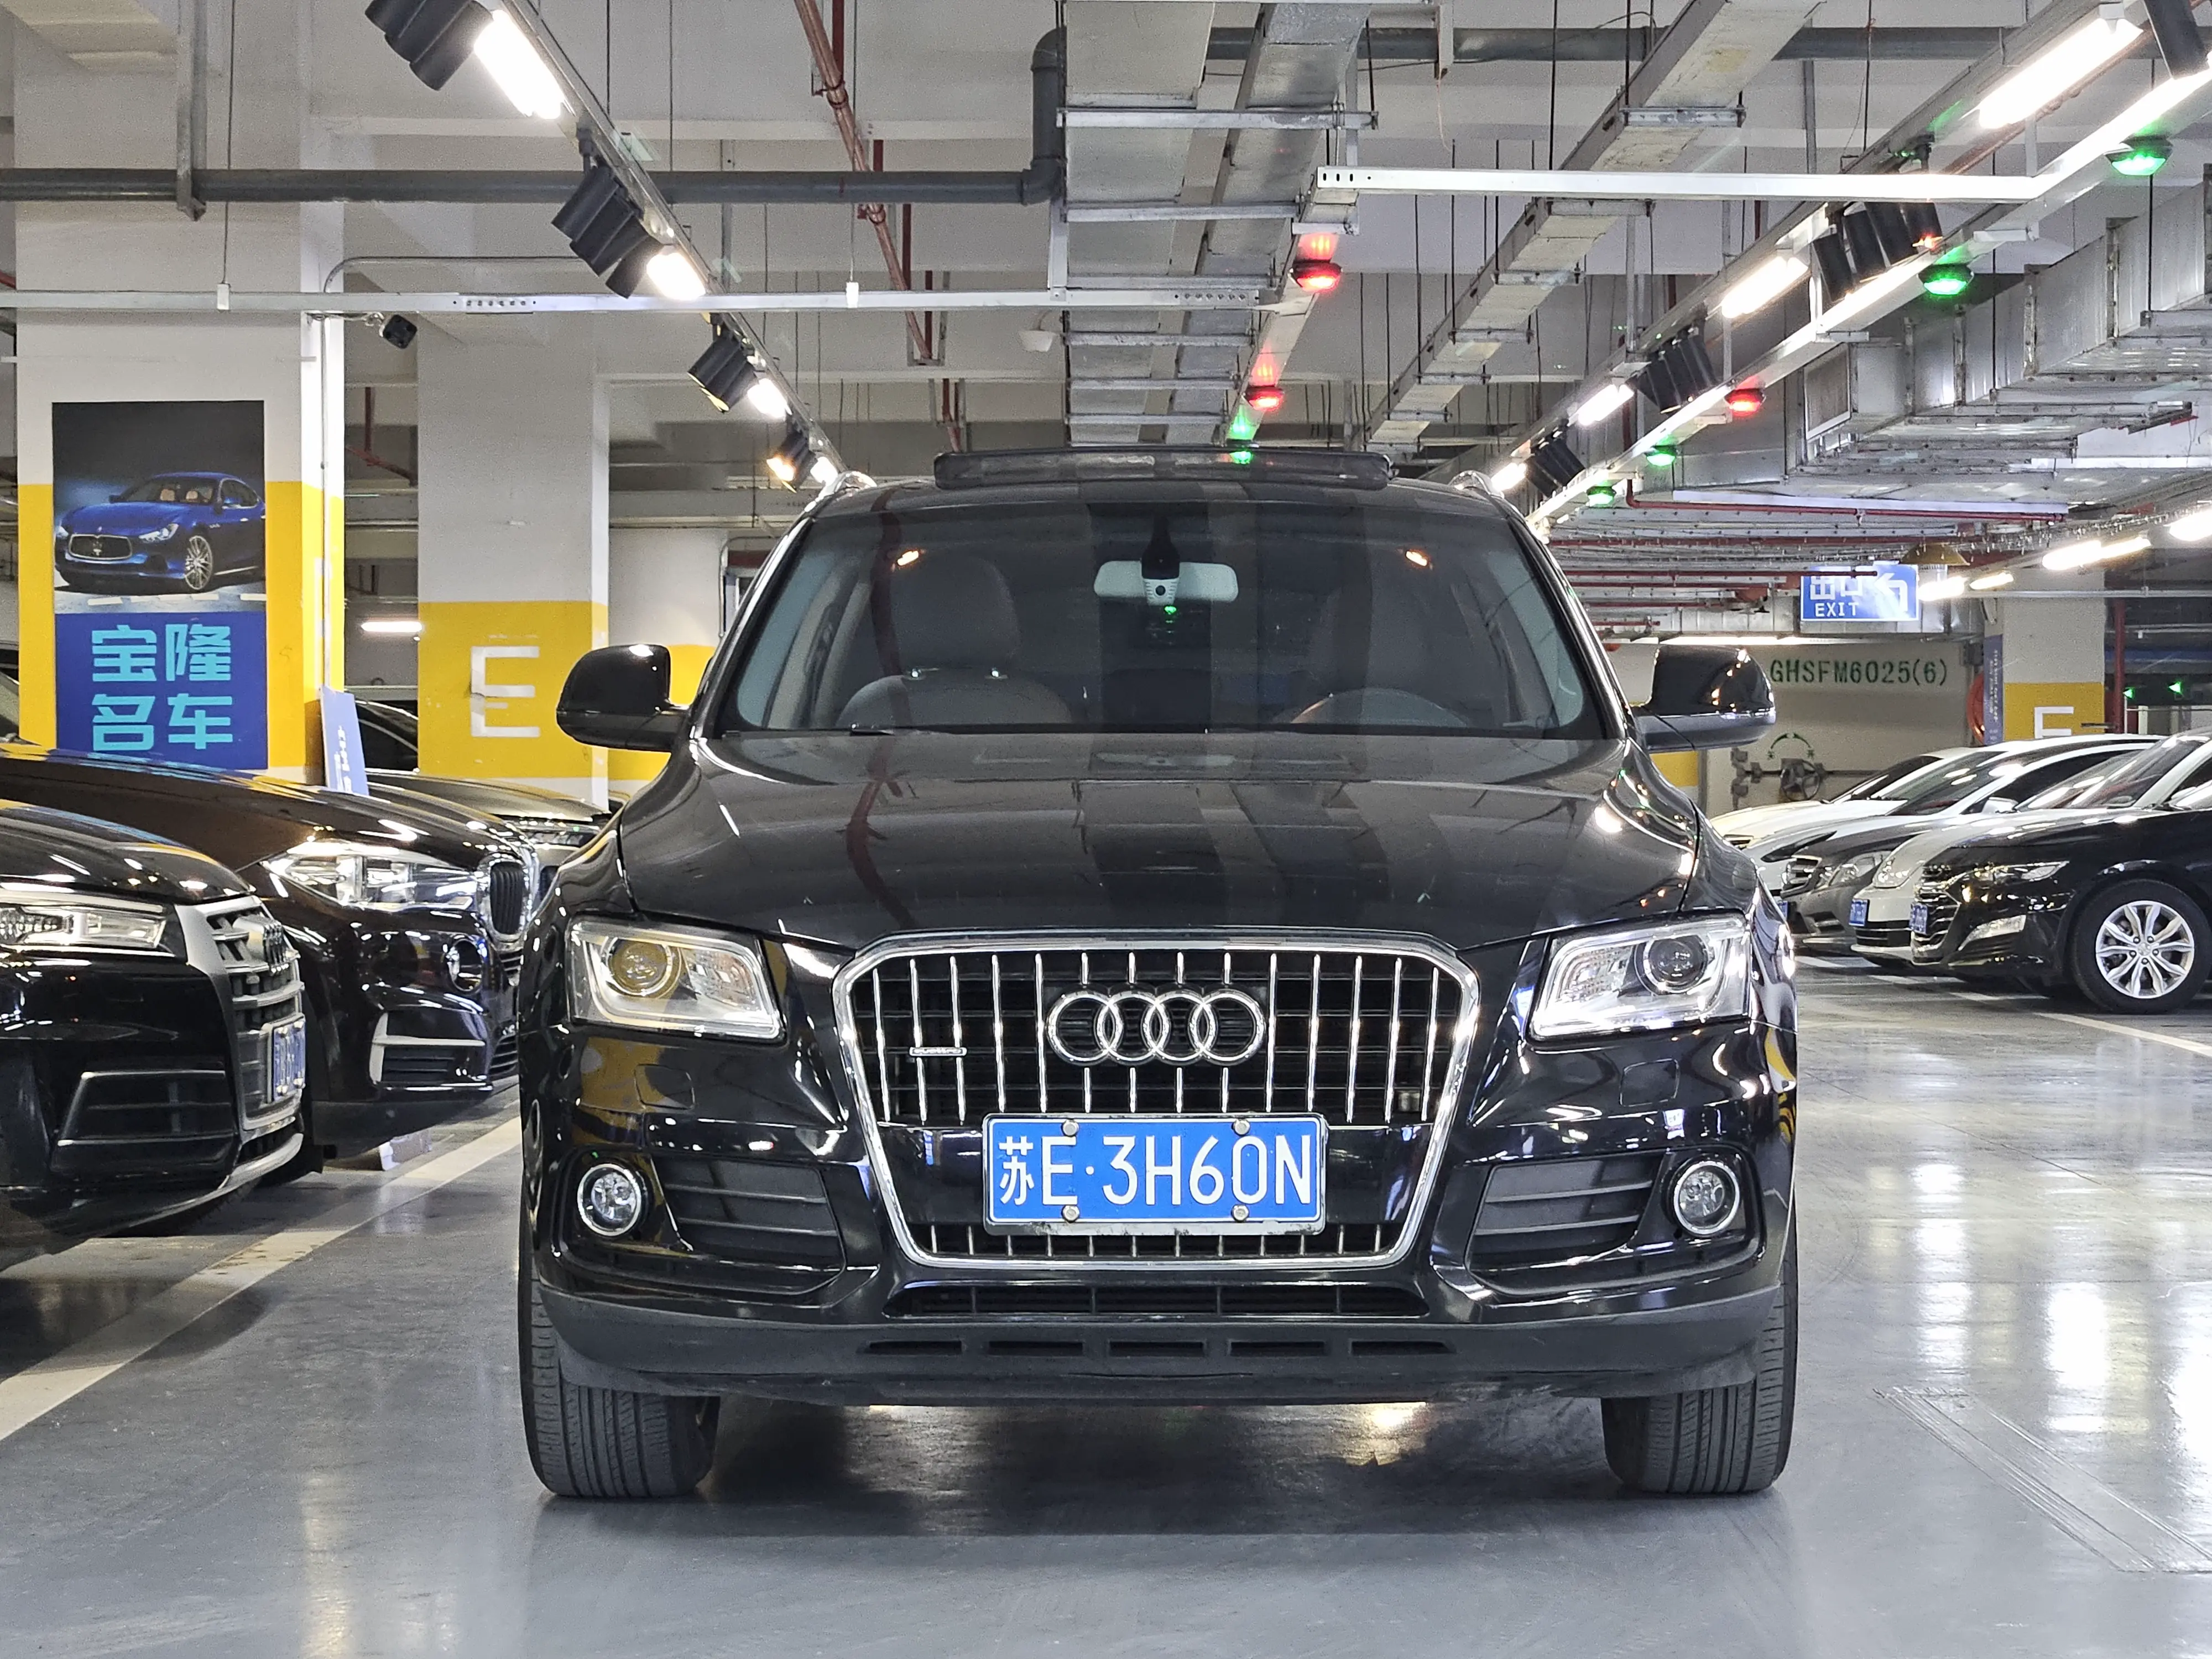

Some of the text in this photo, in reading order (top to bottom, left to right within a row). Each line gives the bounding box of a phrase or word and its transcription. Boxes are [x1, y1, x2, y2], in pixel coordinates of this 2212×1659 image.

[1810, 575, 1863, 600] 出口
[1815, 602, 1859, 617] EXIT
[91, 624, 231, 681] 宝隆
[1770, 658, 1947, 686] GHSFM6025(6)
[471, 645, 541, 738] E
[91, 693, 233, 751] 名车
